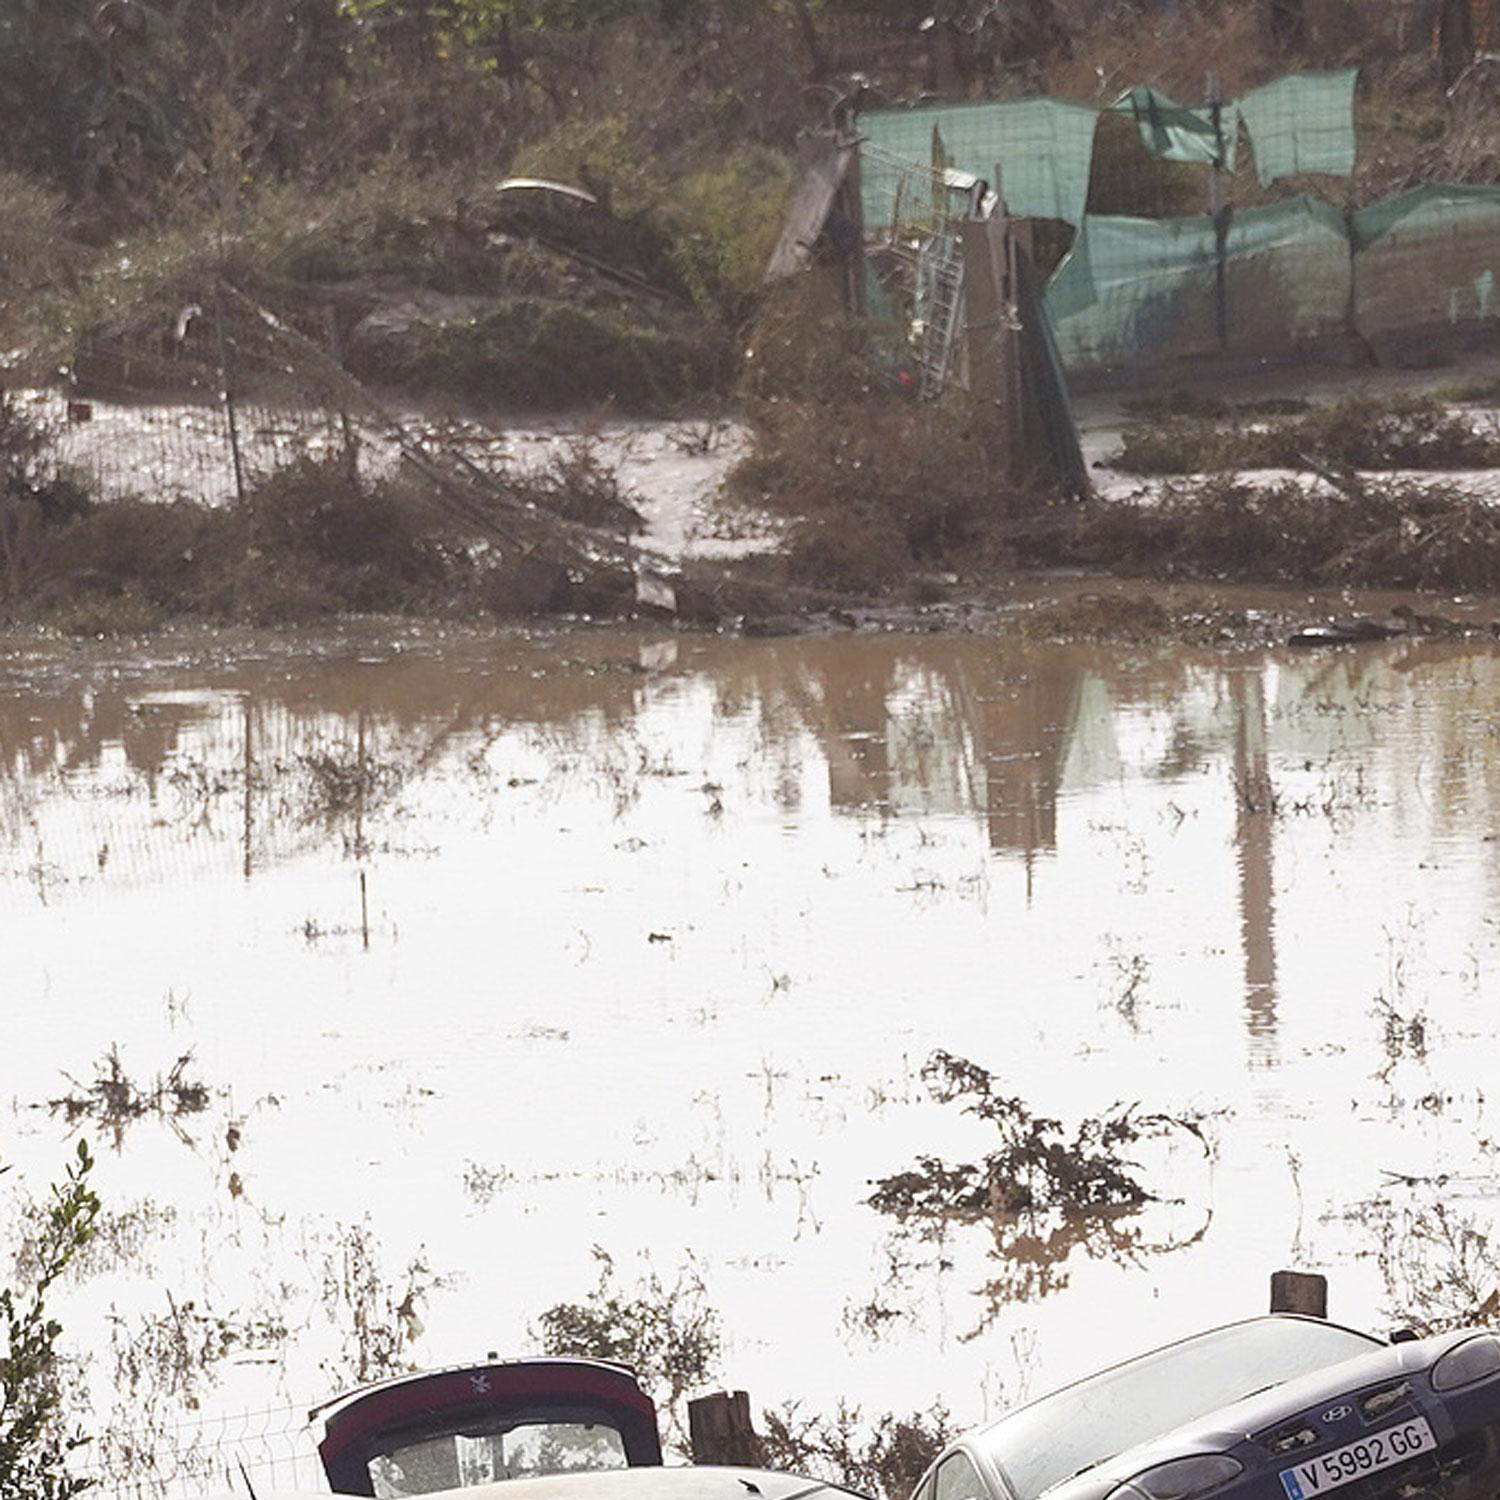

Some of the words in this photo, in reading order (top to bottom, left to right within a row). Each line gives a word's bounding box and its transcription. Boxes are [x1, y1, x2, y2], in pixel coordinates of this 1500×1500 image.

[1301, 1464, 1319, 1489] V
[1322, 1439, 1389, 1482] 5992
[1388, 1426, 1423, 1455] GG
